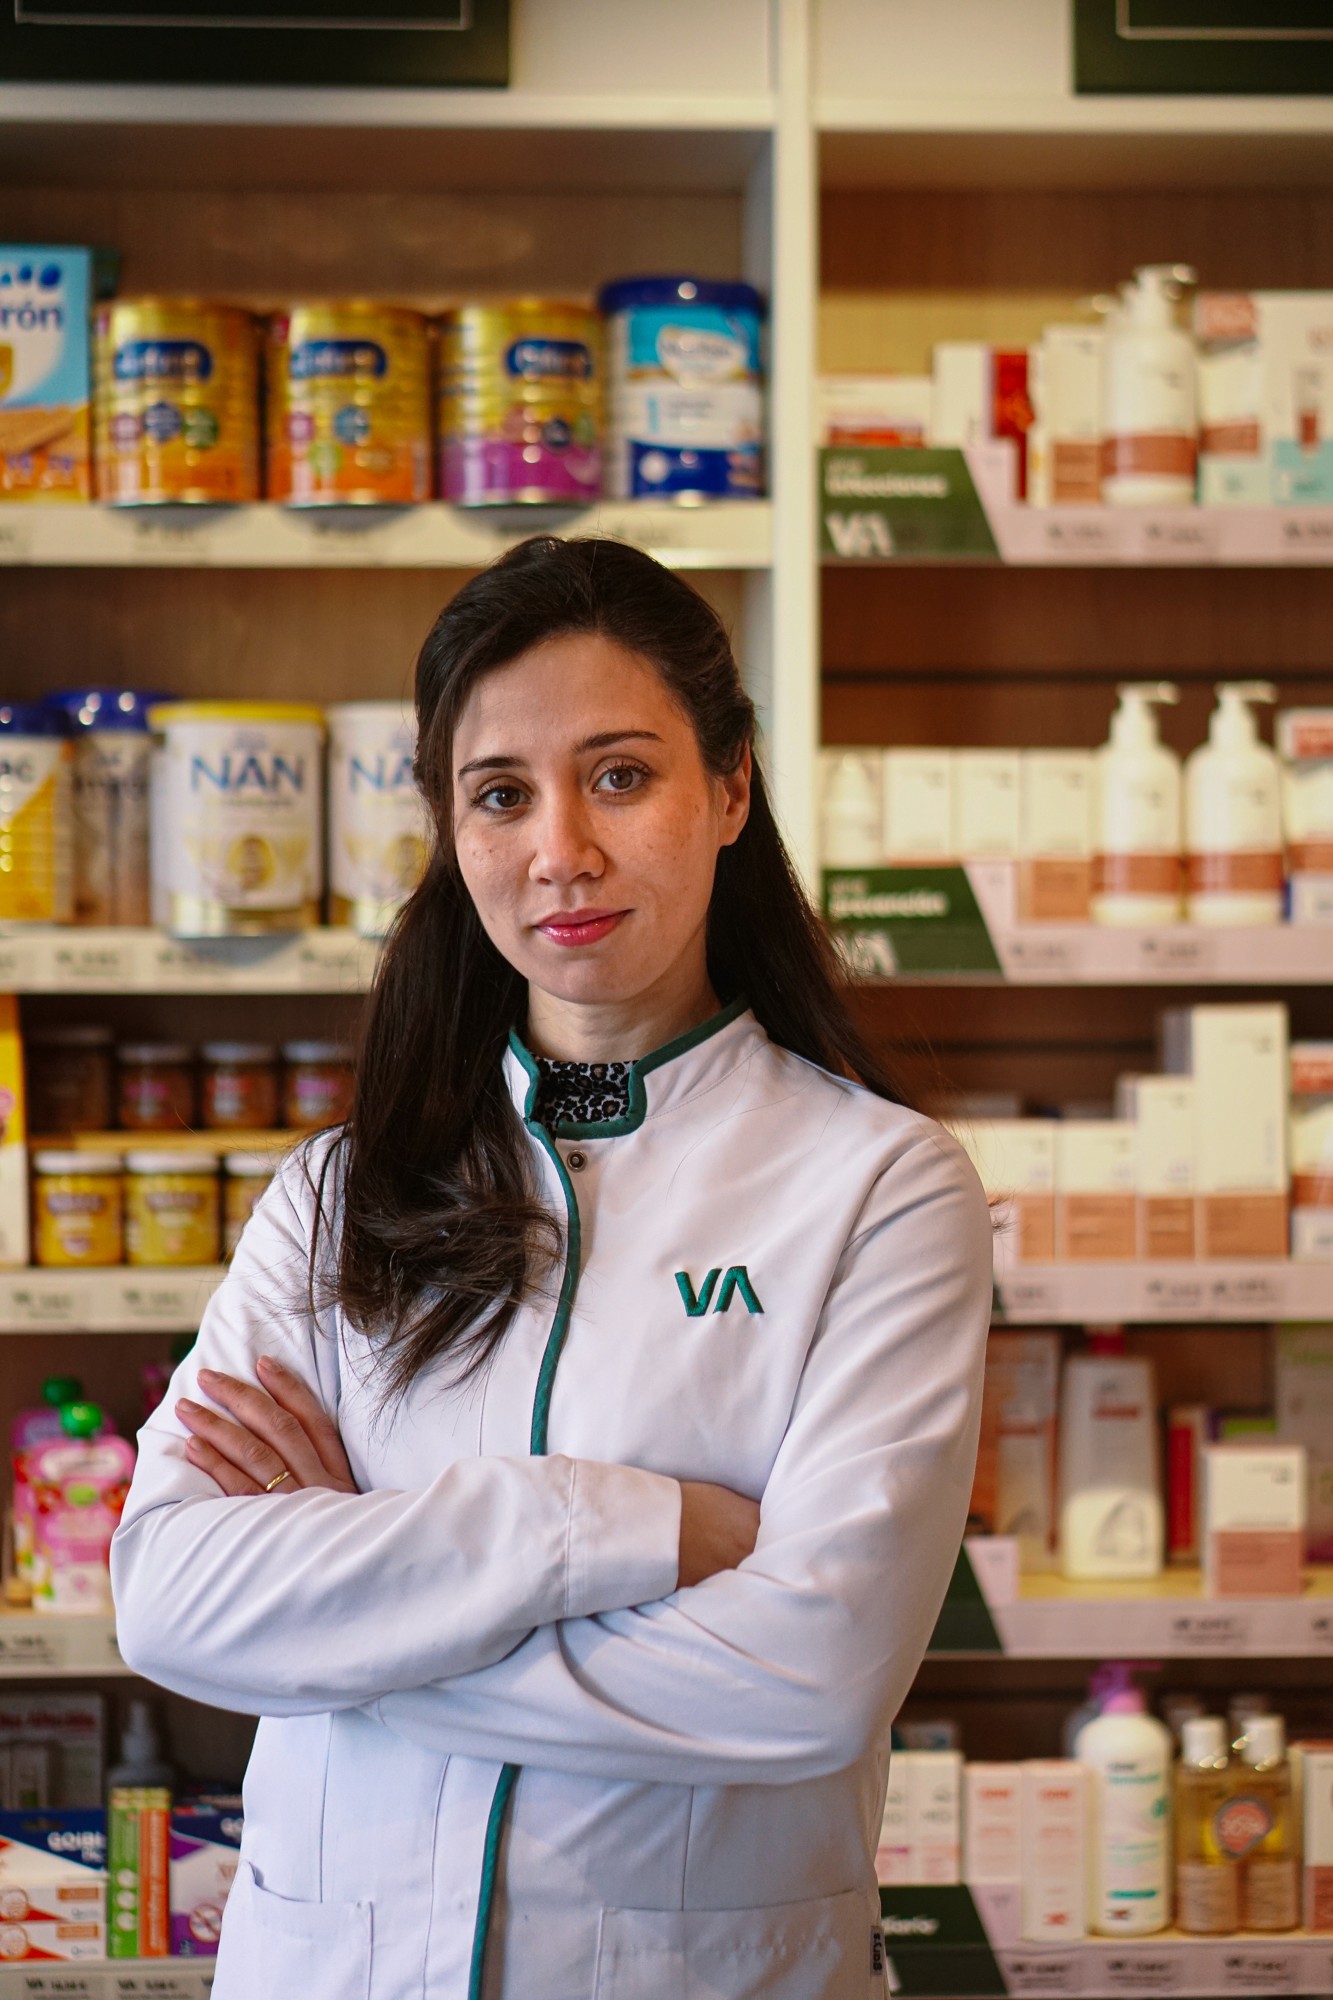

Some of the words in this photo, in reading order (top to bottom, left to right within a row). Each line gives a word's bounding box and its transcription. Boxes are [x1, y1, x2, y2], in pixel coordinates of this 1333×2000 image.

[826, 512, 894, 557] VA
[191, 754, 303, 794] NAN
[349, 754, 416, 794] NA
[675, 1265, 765, 1317] VA
[873, 1933, 882, 1971] garys
